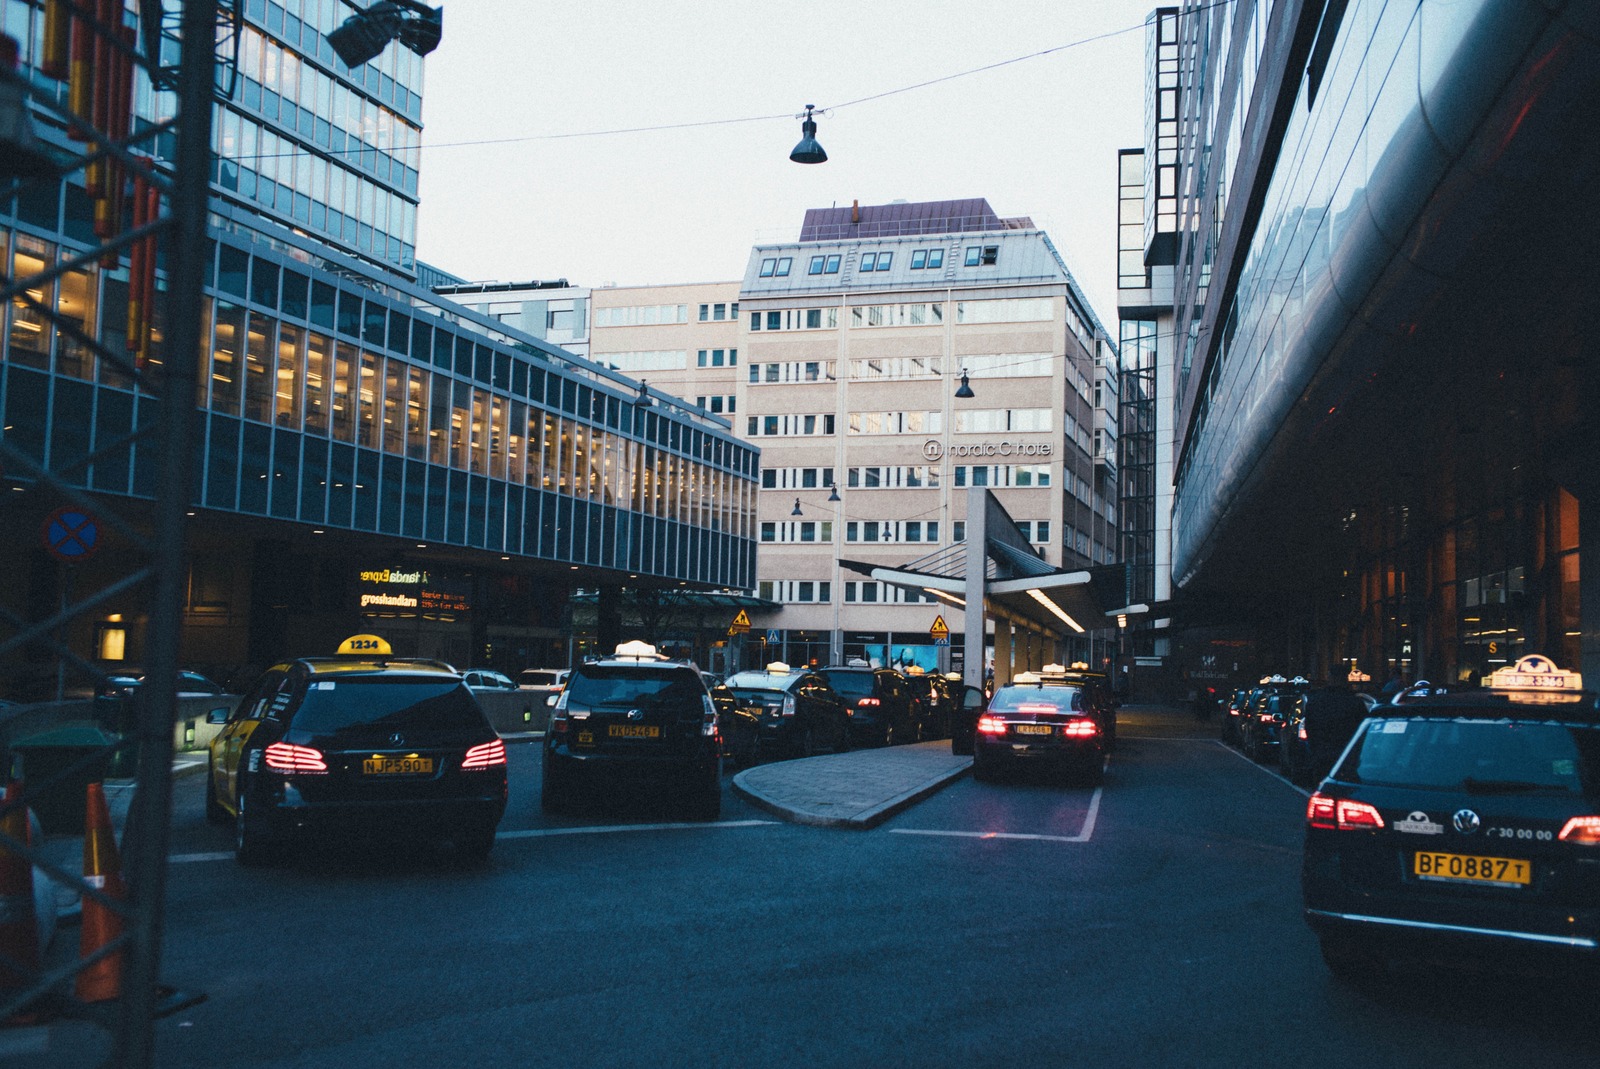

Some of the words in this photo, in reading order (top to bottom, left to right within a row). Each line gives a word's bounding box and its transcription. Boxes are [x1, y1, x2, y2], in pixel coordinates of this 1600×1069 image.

[949, 440, 996, 457] nordic
[1000, 441, 1012, 456] C
[1016, 441, 1054, 456] hotel
[350, 640, 379, 649] 1234
[1499, 828, 1514, 838] 30
[1517, 829, 1533, 839] 00
[1536, 830, 1552, 840] 00
